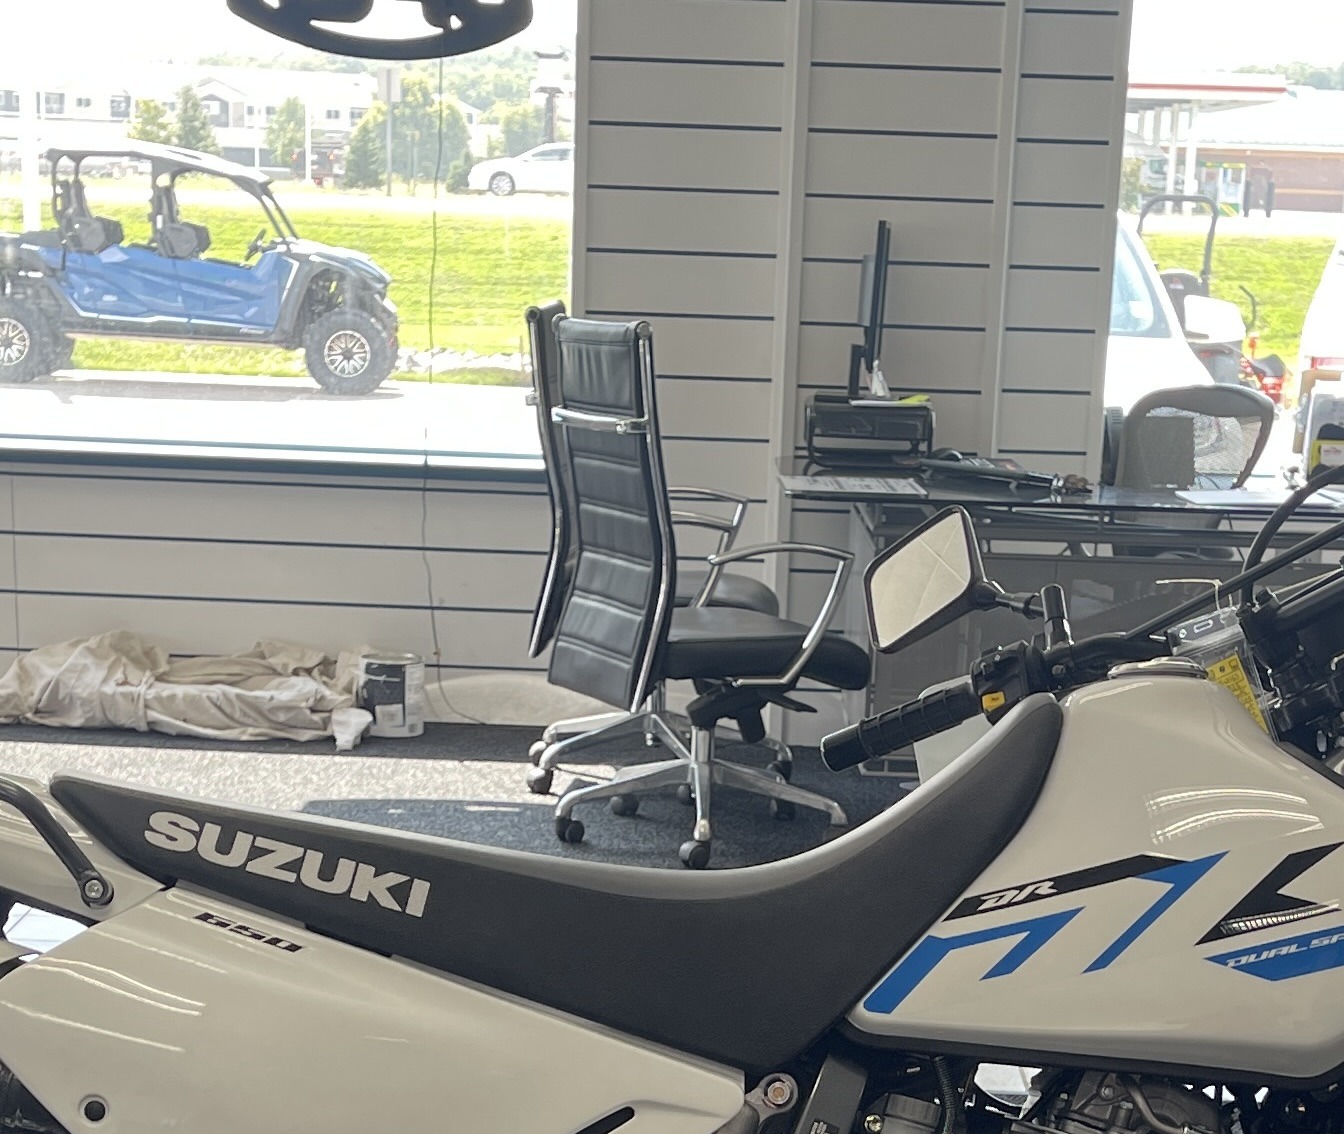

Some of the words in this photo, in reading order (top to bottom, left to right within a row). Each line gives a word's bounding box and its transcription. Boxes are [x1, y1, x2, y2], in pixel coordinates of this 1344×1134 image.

[144, 811, 431, 918] SUZUKI
[976, 880, 1058, 911] DR
[193, 912, 305, 953] 650
[1225, 943, 1308, 968] DUAL
